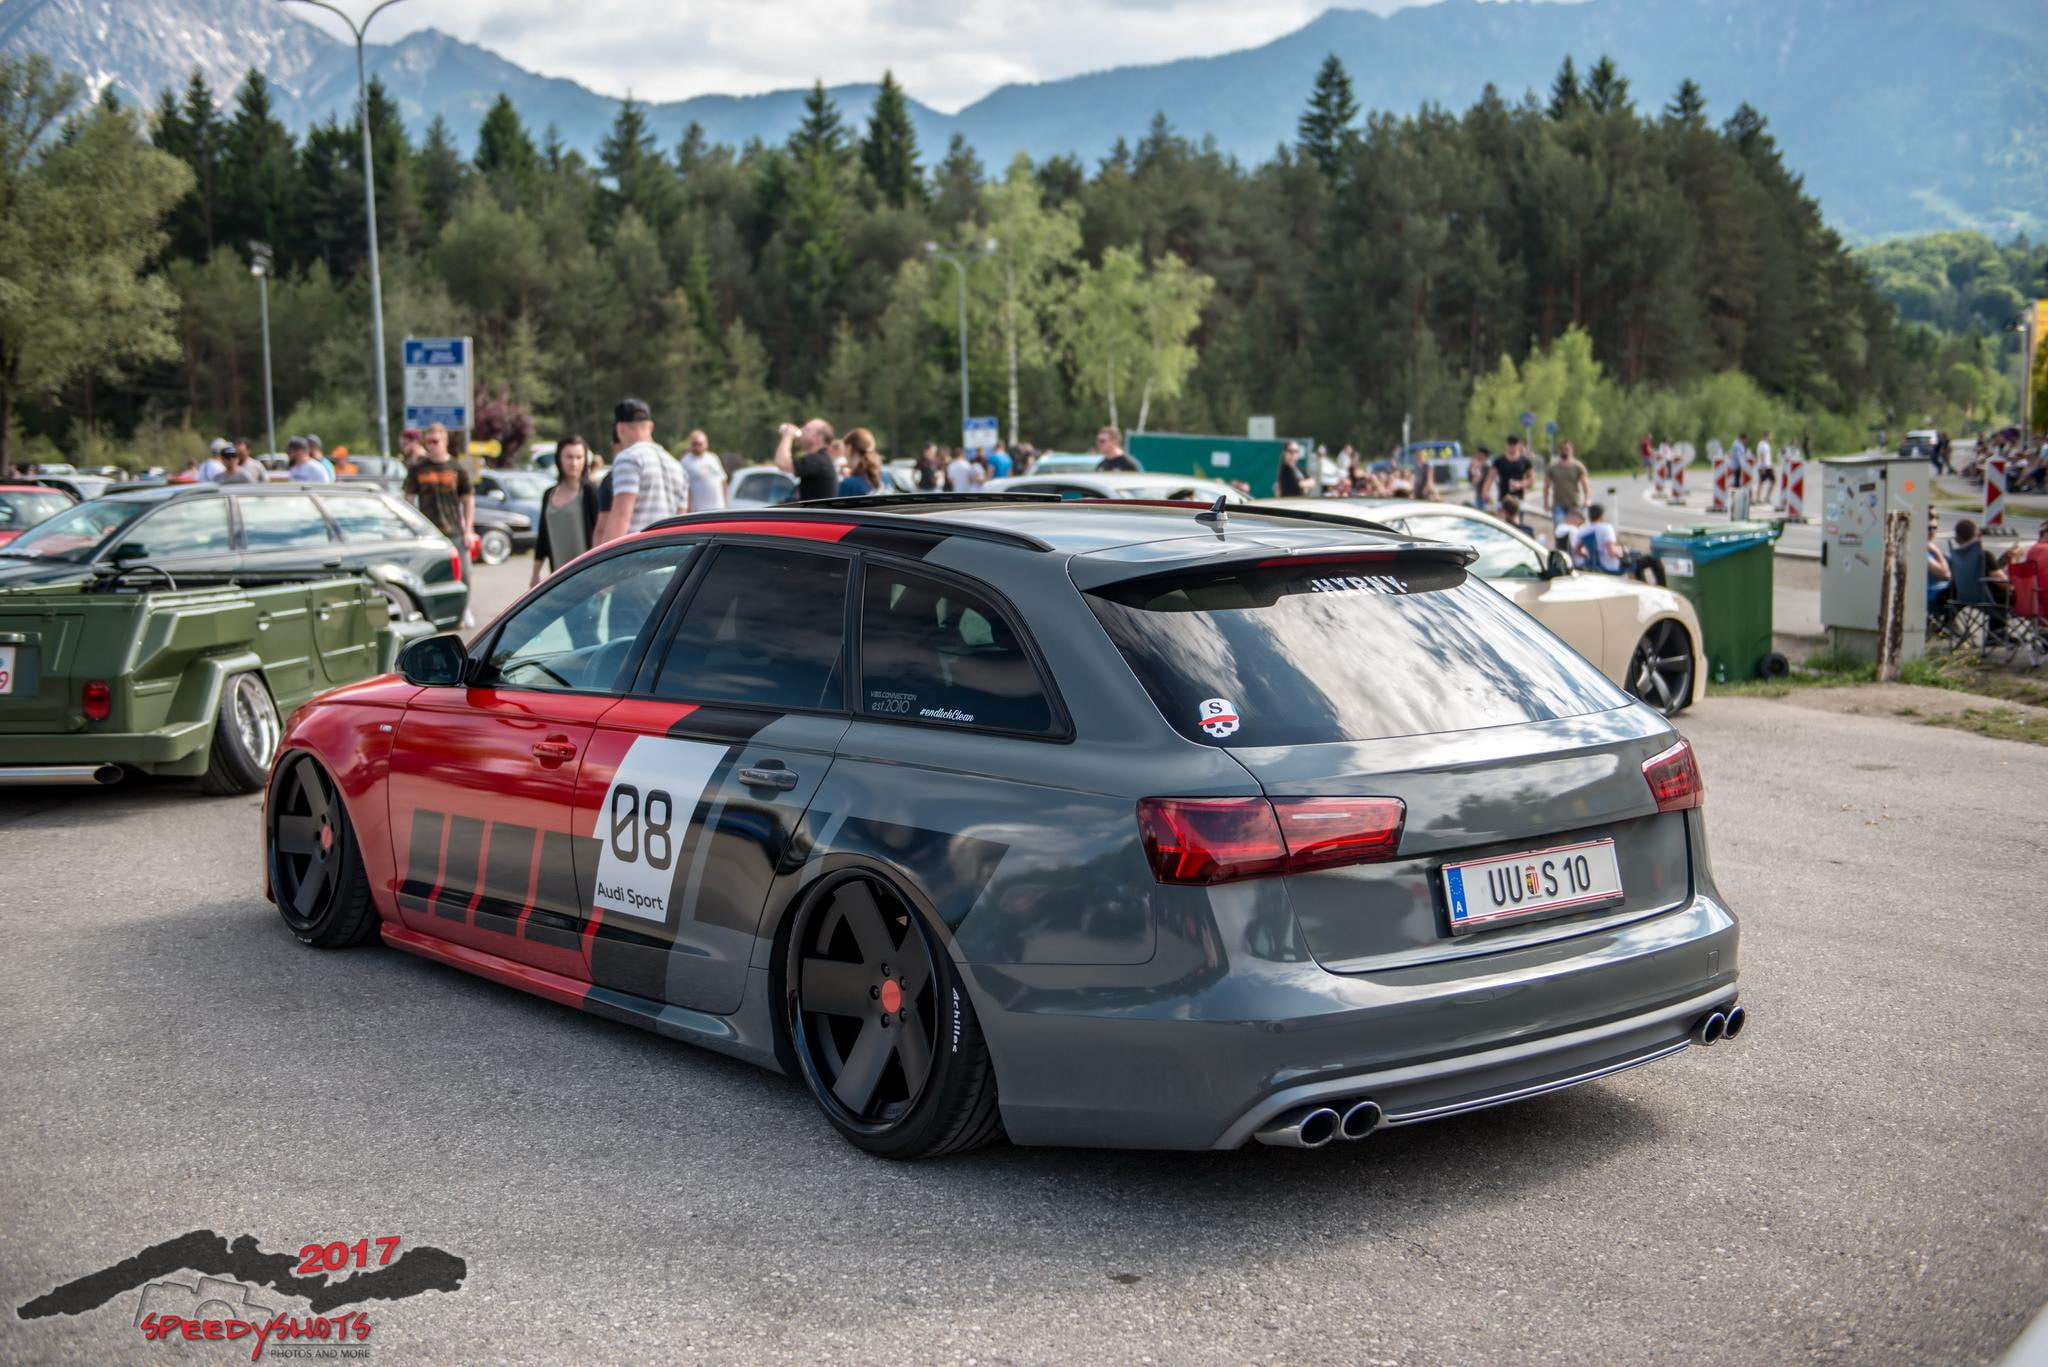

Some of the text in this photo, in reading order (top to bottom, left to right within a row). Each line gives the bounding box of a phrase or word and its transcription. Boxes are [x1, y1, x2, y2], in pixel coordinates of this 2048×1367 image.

[1208, 701, 1223, 714] S
[597, 882, 664, 910] Audi Sport
[1488, 866, 1524, 906] UU
